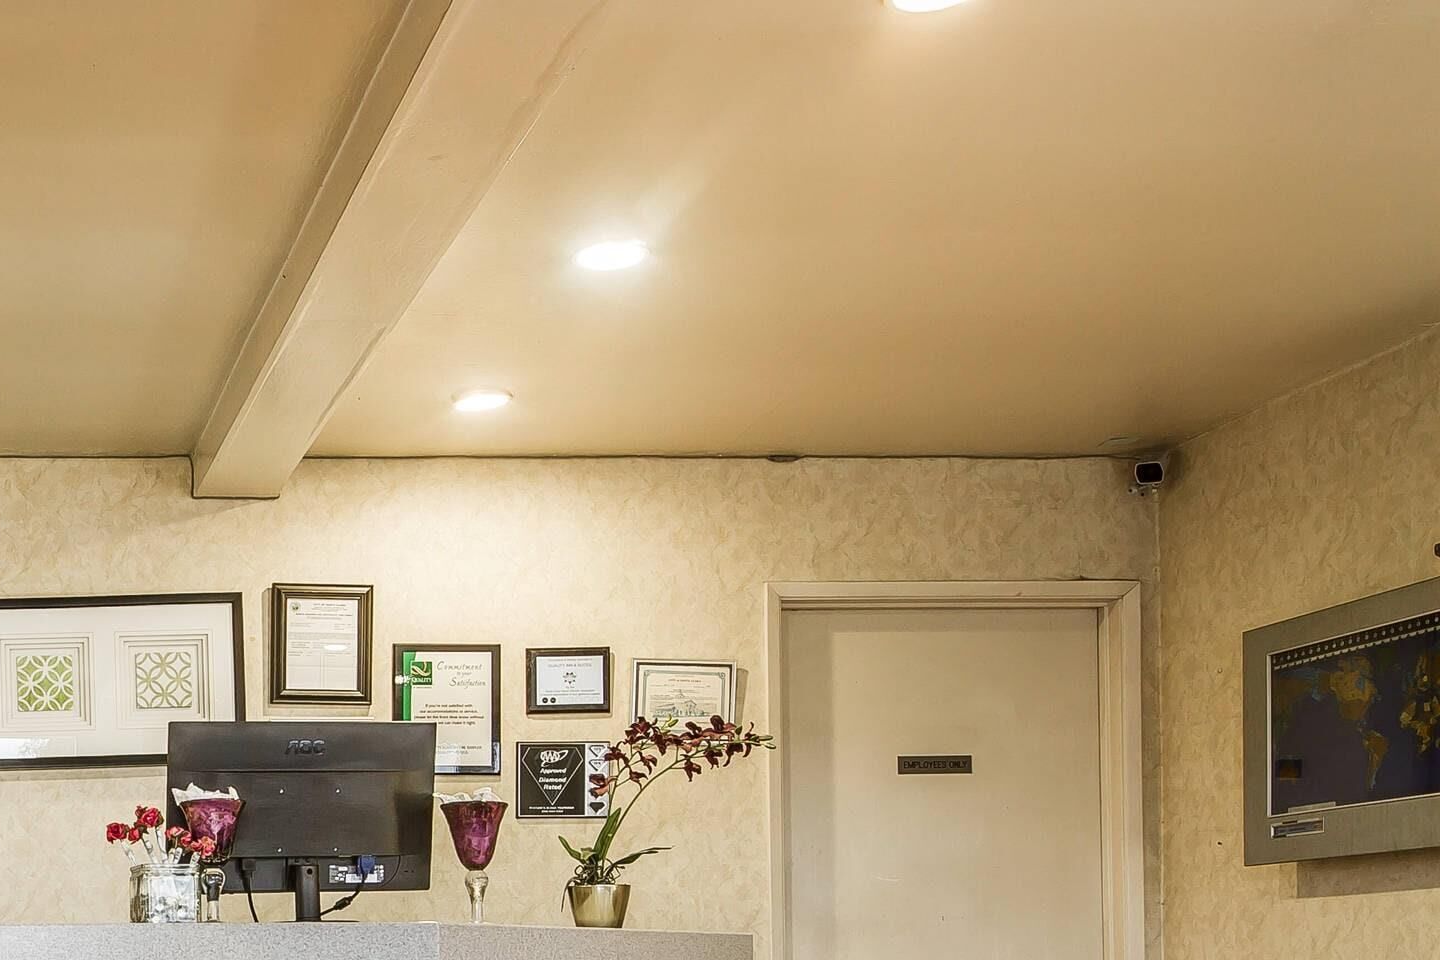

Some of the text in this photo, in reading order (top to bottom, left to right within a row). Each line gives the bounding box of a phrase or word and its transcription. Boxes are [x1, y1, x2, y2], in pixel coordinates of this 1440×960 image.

[436, 660, 483, 671] Commitment
[448, 676, 487, 689] Satisfaction
[285, 739, 326, 756] AOC
[903, 760, 968, 769] EMPLOYEES ONLY
